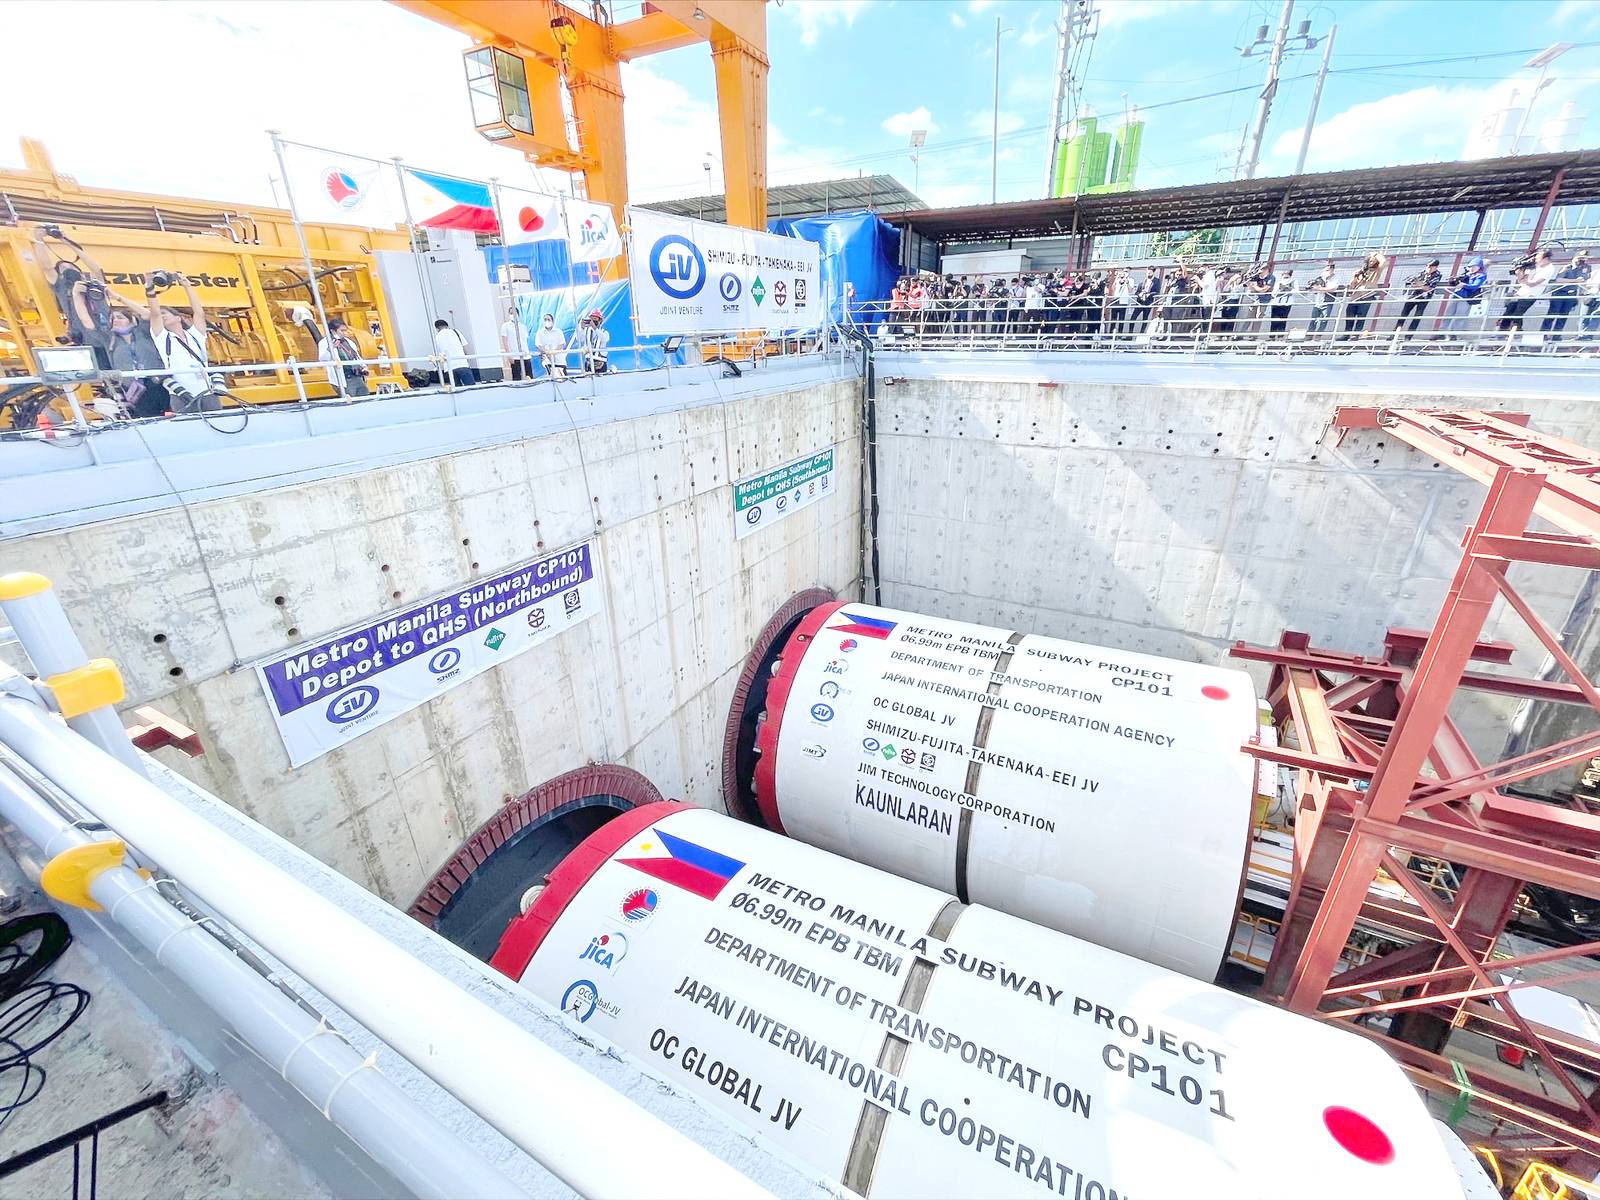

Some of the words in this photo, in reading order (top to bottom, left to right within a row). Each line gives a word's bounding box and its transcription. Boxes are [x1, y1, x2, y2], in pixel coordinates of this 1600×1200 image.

[707, 249, 736, 265] SHIMIZU
[806, 262, 813, 273] JV
[660, 305, 677, 316] JOINT
[678, 306, 703, 316] VENTURE
[738, 479, 763, 496] Metro
[763, 470, 788, 486] Manila
[741, 489, 765, 507] Depot
[766, 487, 774, 497] to
[775, 477, 791, 493] QHS
[284, 634, 369, 680] Metro
[375, 601, 453, 641] Manila
[458, 570, 532, 609] Subway
[536, 548, 586, 579] CP101
[301, 651, 384, 700] Depot
[389, 642, 415, 660] to
[421, 615, 468, 646] QHS
[473, 566, 584, 628] (Northbound)
[889, 649, 965, 675] DEPARTMENT
[967, 666, 985, 678] OF
[988, 671, 1103, 704] TRANSPORTATION
[906, 625, 953, 640] METRO
[959, 635, 1016, 653] MANILA
[1026, 648, 1093, 667] SUBWAY
[1098, 661, 1174, 683] PROJECT
[944, 642, 971, 656] EPB
[972, 647, 1001, 661] TBM
[872, 696, 890, 709] OC
[891, 701, 937, 722] GLOBAL
[940, 712, 957, 727] JV
[880, 670, 916, 688] JAPAN
[916, 680, 1011, 712] INTERNATIONAL
[1012, 701, 1112, 735] COOPERATION
[1112, 723, 1177, 750] AGENCY
[1110, 676, 1174, 698] CP101
[338, 722, 355, 734] JOINT
[354, 709, 380, 726] VENTURE
[854, 783, 953, 836] KAUNLARAN
[857, 762, 877, 776] JIM
[880, 768, 957, 802] TECHNOLOGY
[956, 794, 1056, 834] CORPORATION
[1080, 779, 1100, 794] JV
[748, 872, 827, 912] METRO
[829, 904, 929, 956] MANILA
[939, 946, 1064, 1007] SUBWAY
[1072, 996, 1228, 1076] PROJECT
[806, 922, 852, 954] EPB
[852, 940, 904, 978] TBM
[704, 926, 836, 1001] DEPARTMENT
[834, 985, 868, 1011] OF
[870, 999, 1093, 1119] TRANSPORTATION
[649, 1027, 680, 1052] OC
[680, 1046, 764, 1114] GLOBAL
[769, 1097, 803, 1131] JV
[673, 975, 738, 1022] JAPAN
[734, 1004, 912, 1117] INTERNATIONAL
[919, 1097, 1129, 1200] COOPERATIO
[1101, 1043, 1236, 1123] CP101
